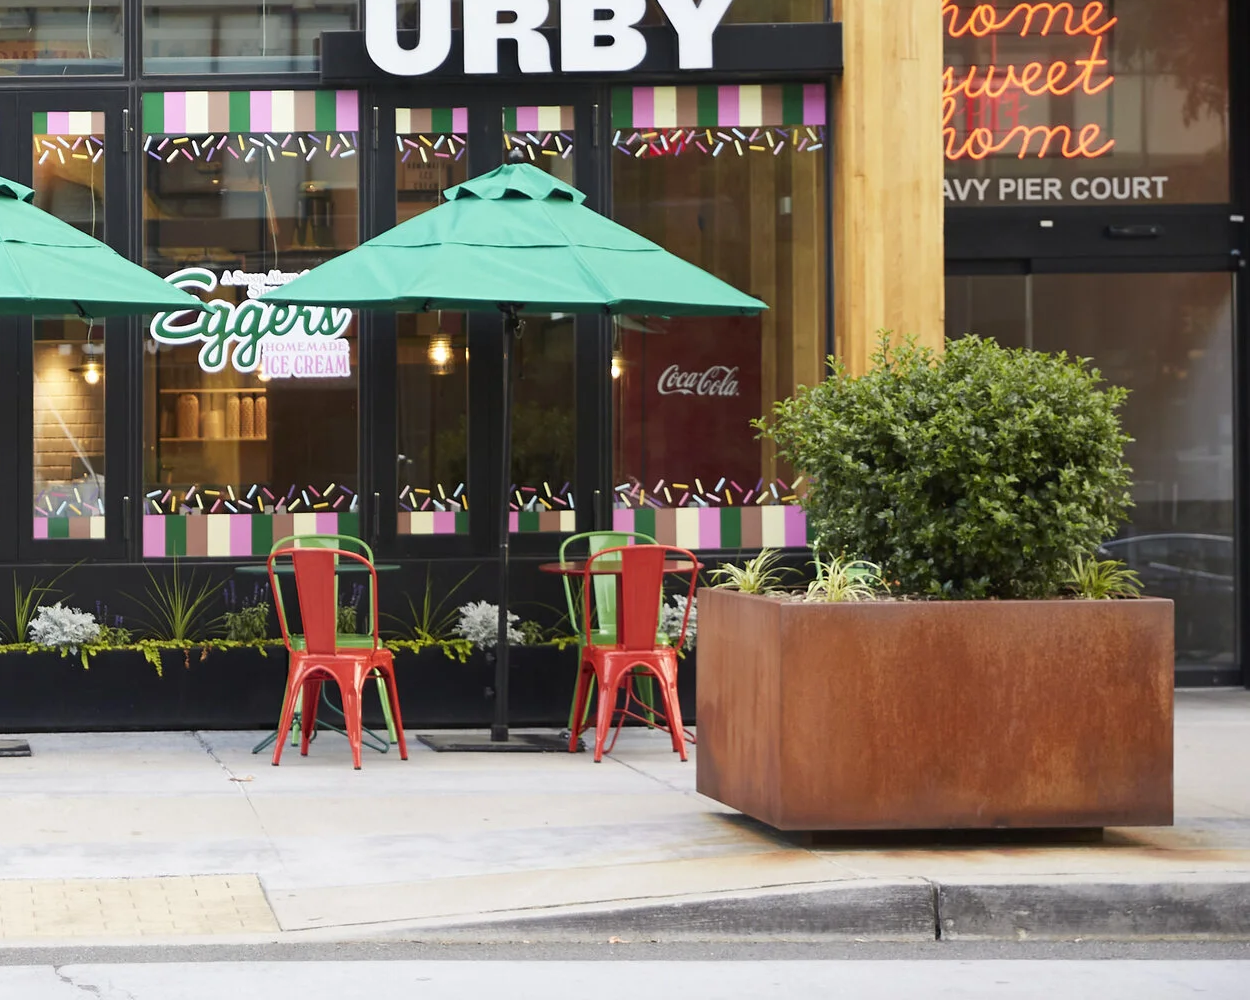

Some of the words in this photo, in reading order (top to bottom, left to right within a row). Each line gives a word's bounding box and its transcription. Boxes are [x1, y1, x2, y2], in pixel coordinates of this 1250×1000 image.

[942, 35, 1115, 98] sweet
[942, 97, 1116, 160] home
[999, 177, 1063, 201] PIER
[1070, 176, 1169, 201] COURT
[153, 271, 348, 369] Eggers
[265, 341, 346, 352] HOMEMADE
[264, 356, 290, 375] ICE
[294, 355, 348, 375] CREAM
[657, 364, 740, 396] Coca-Cola
